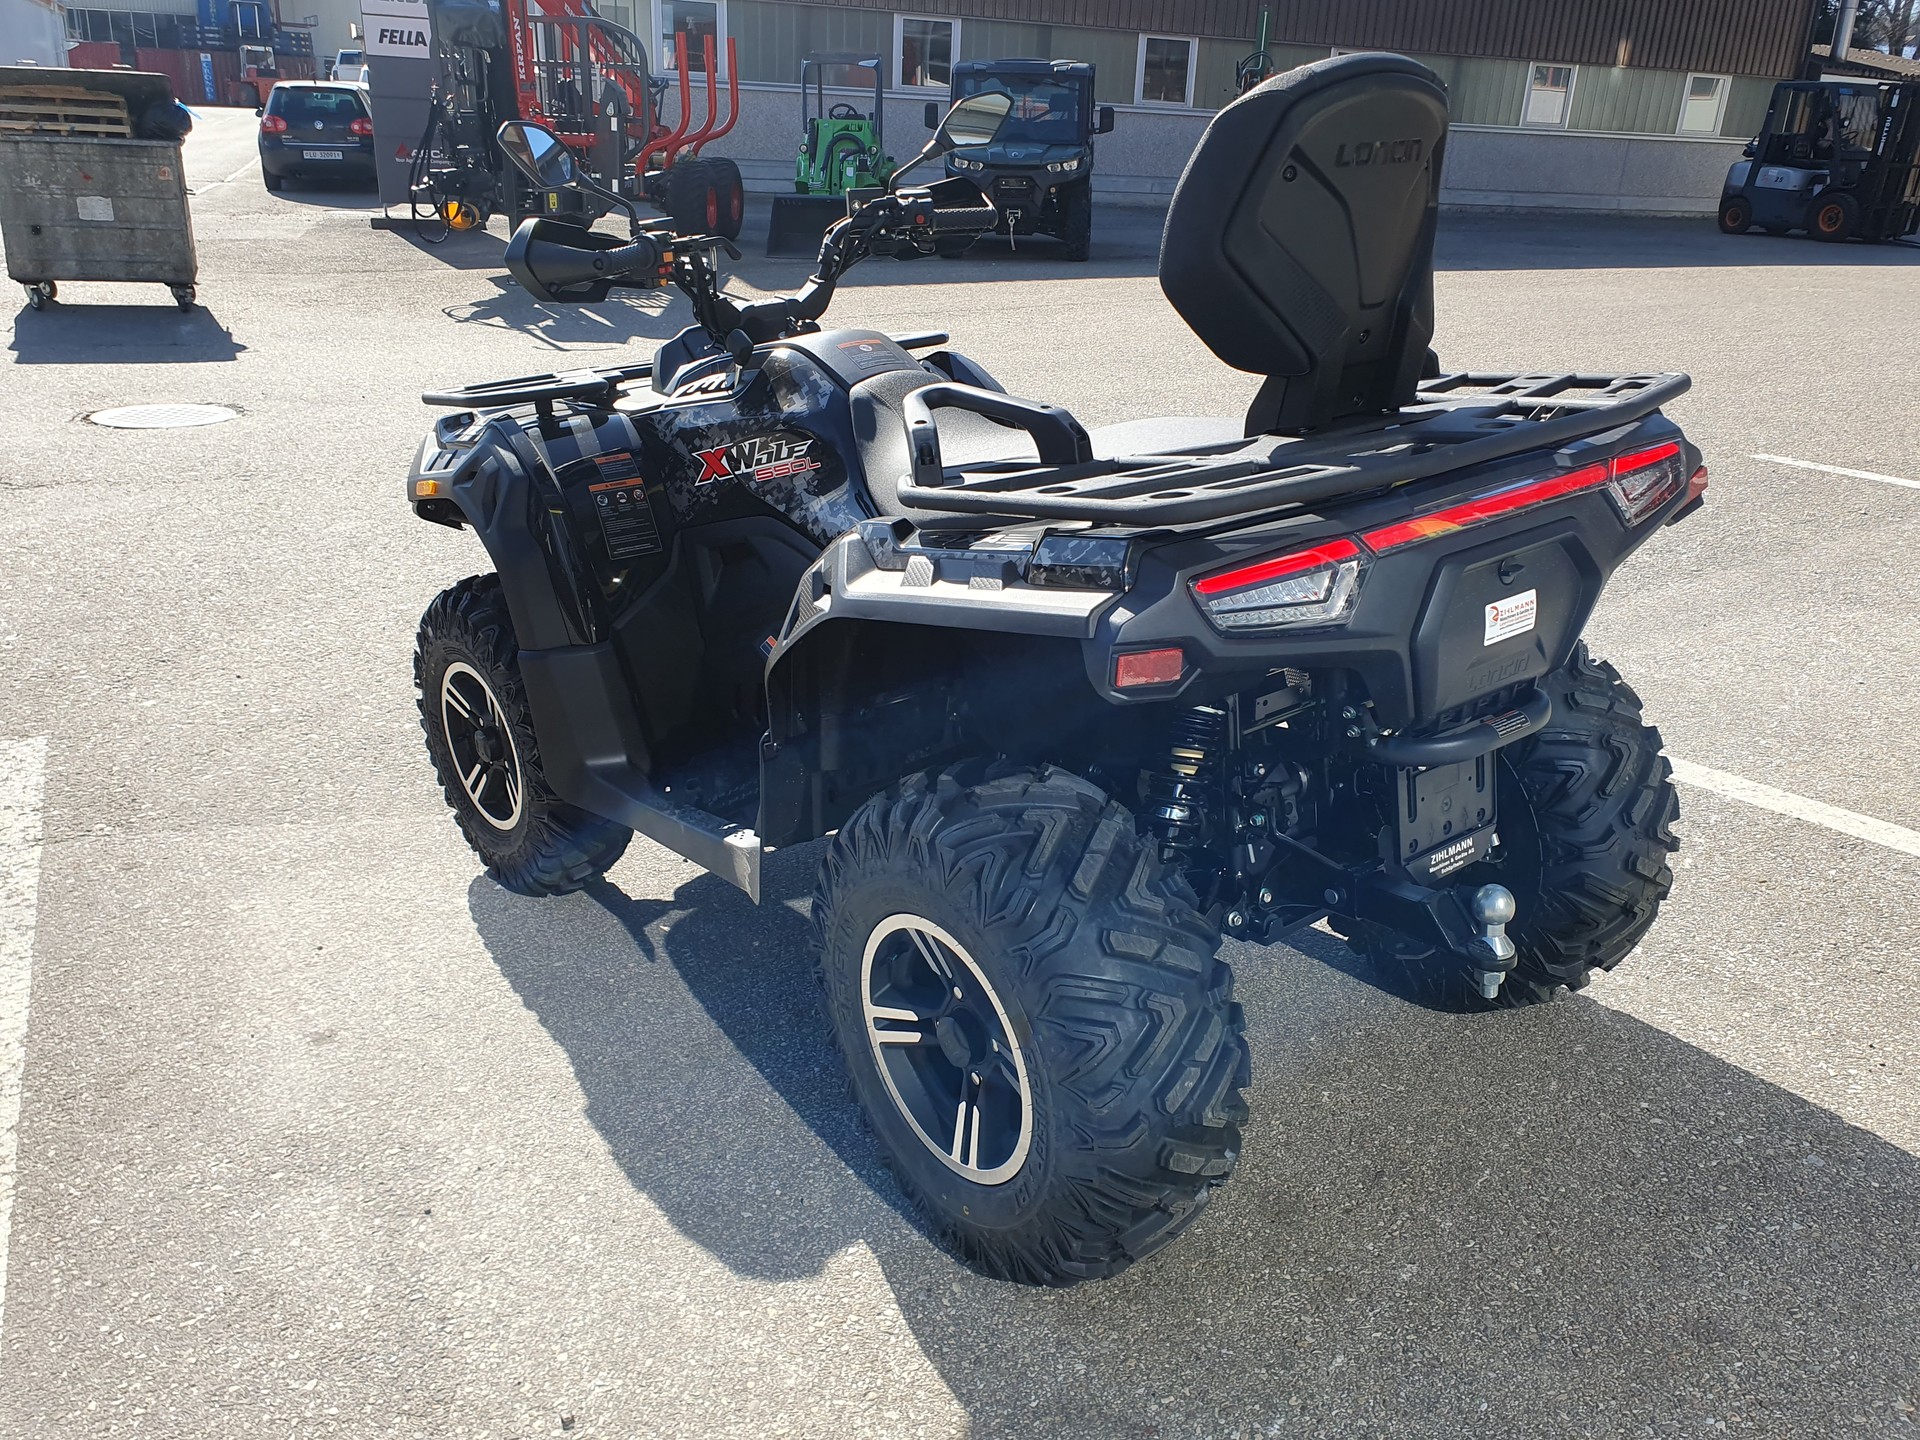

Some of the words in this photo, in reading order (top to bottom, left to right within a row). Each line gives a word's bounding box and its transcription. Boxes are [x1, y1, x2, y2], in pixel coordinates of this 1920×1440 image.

[378, 28, 428, 47] FELLA
[512, 17, 527, 80] KRPAN
[1430, 837, 1473, 865] ZIHLMANN
